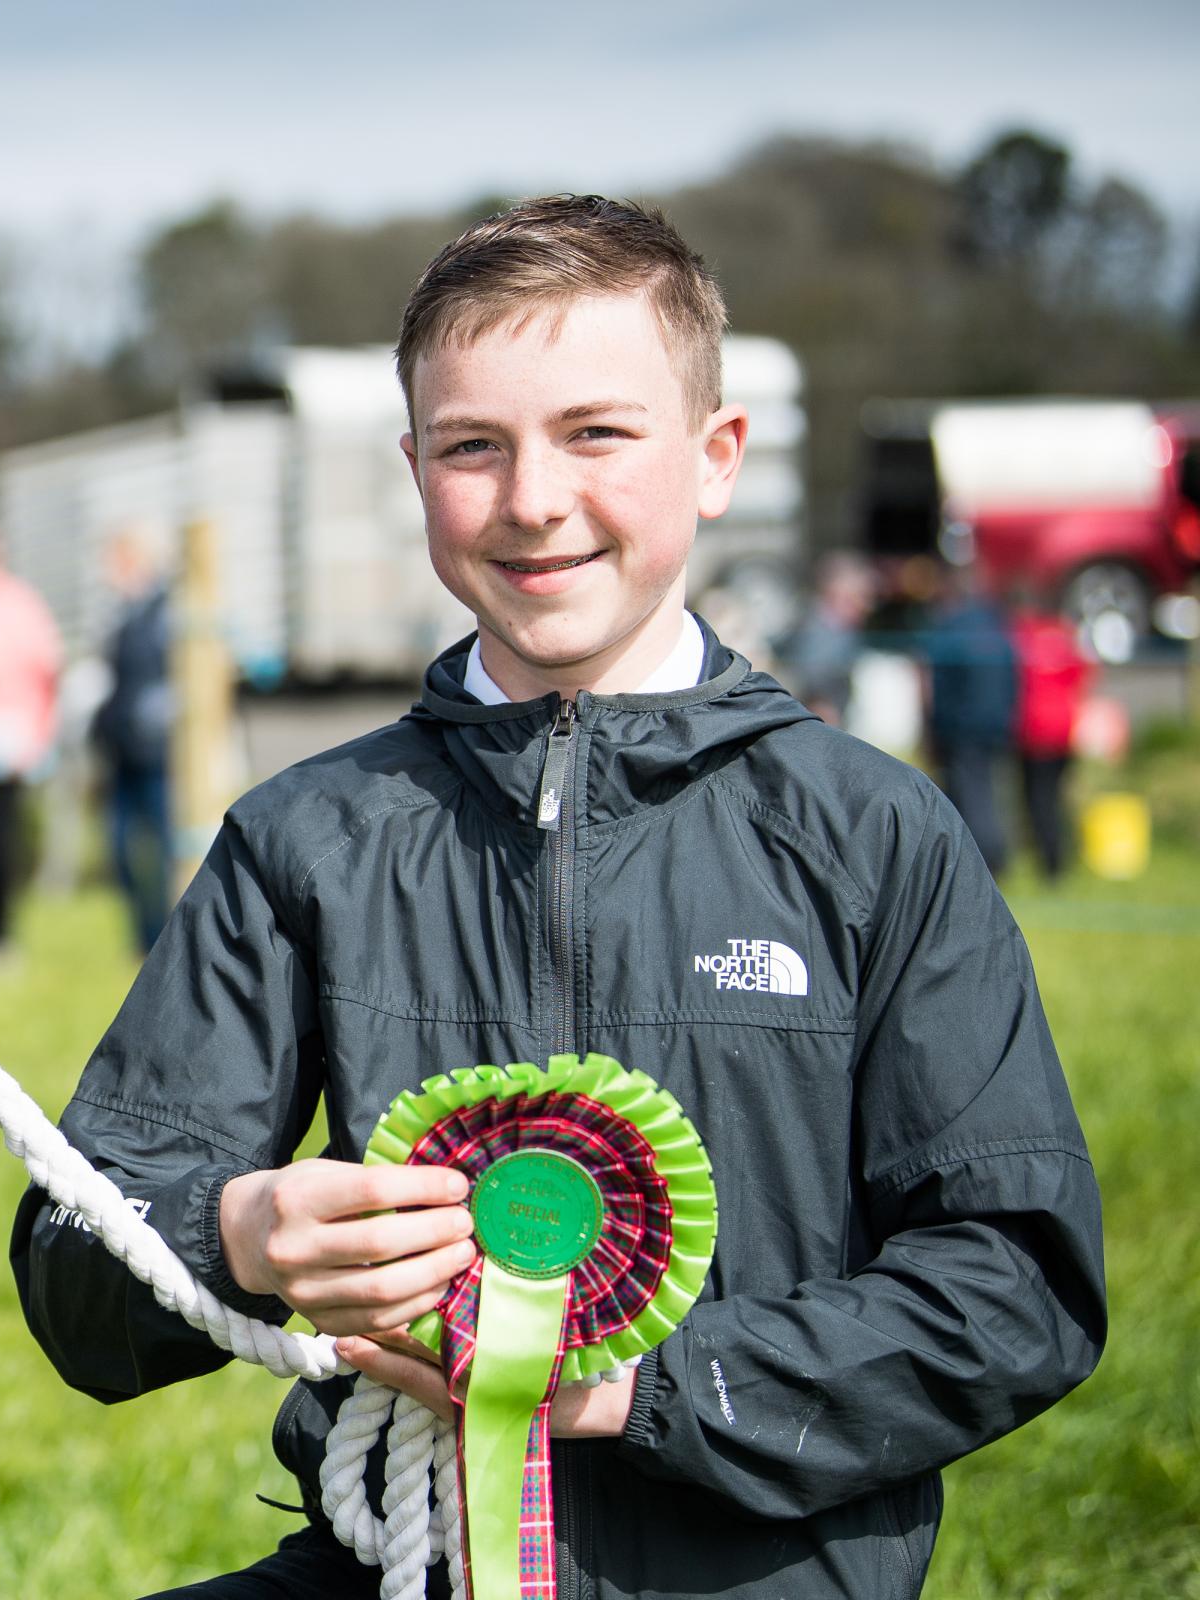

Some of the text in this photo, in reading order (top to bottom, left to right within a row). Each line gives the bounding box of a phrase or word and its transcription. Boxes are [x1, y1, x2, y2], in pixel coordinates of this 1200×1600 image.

[727, 939, 769, 957] THE
[694, 955, 769, 975] NORTH
[716, 972, 769, 992] FACE
[508, 1201, 561, 1226] SPECIAL
[710, 1358, 735, 1425] WINDWALL
